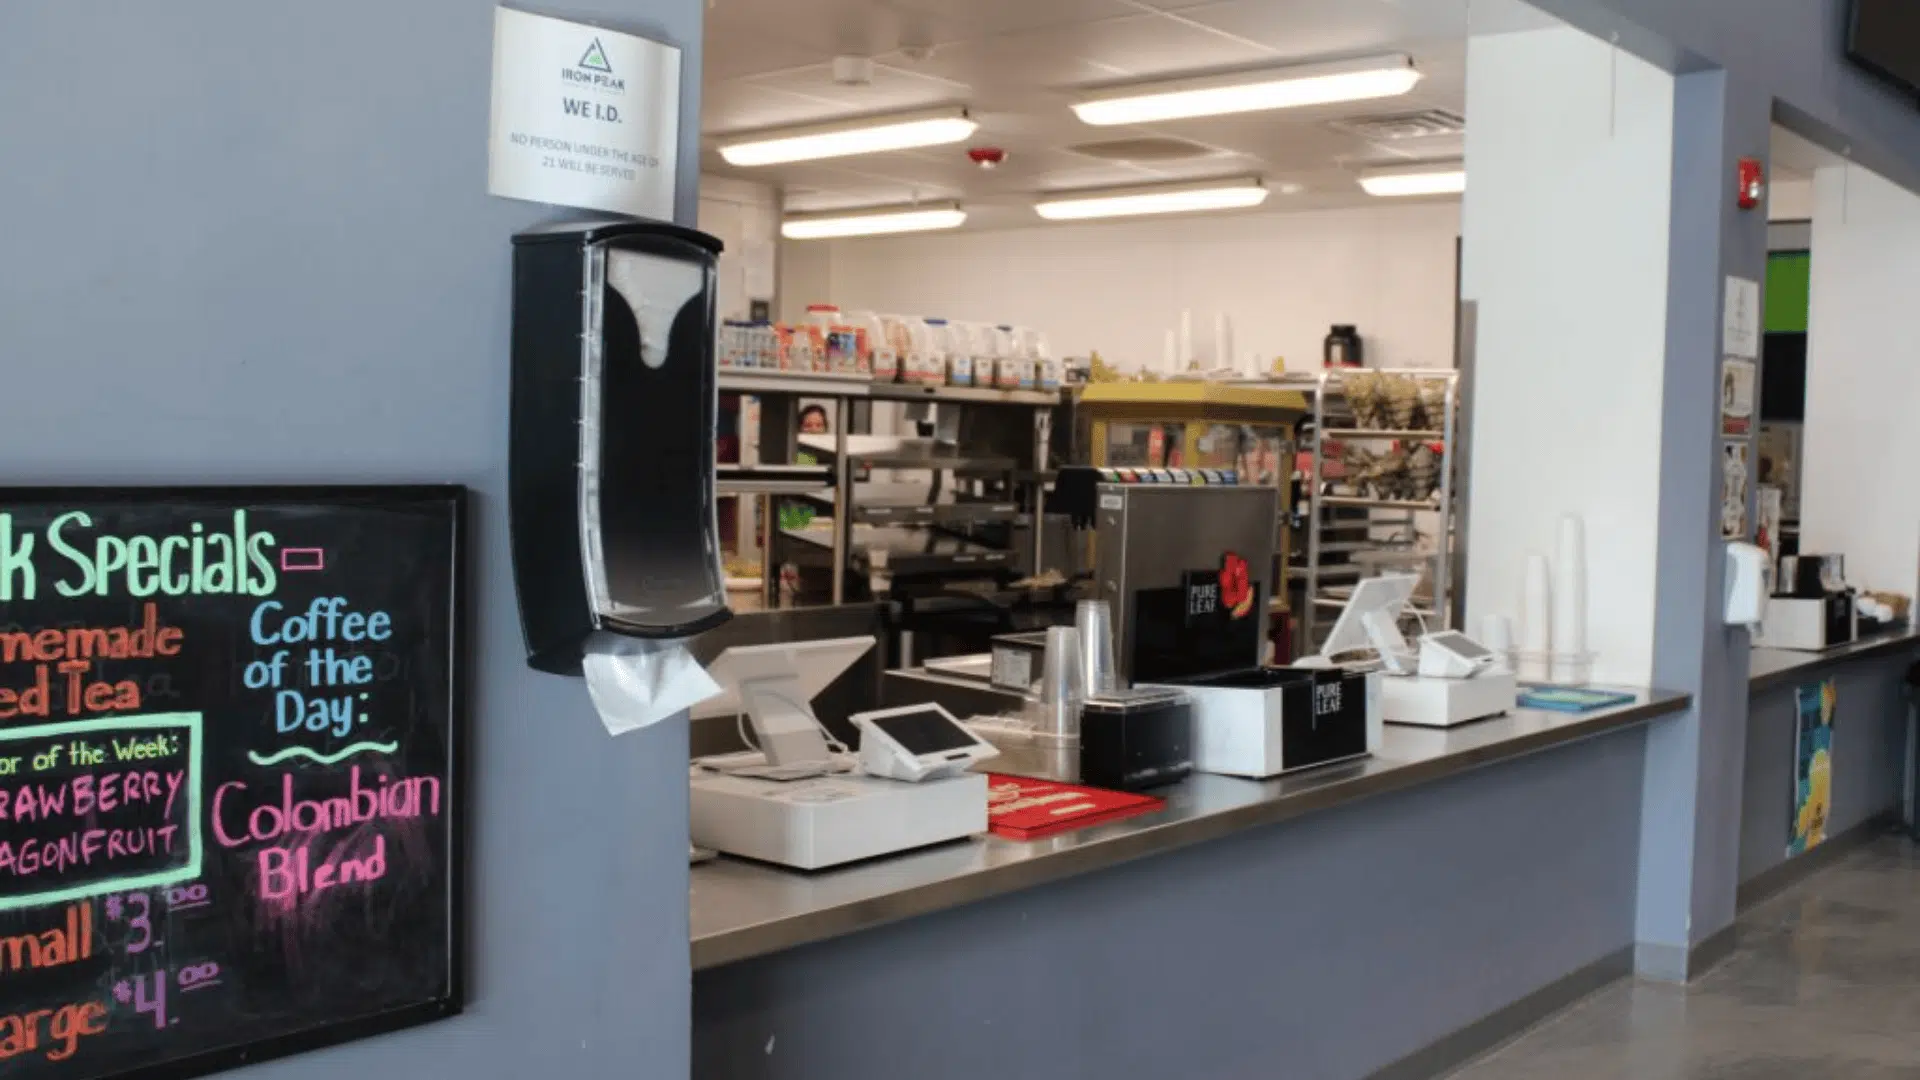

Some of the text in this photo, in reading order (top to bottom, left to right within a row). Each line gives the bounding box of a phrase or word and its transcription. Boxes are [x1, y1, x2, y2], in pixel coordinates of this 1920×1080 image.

[562, 68, 592, 83] IRON
[593, 75, 625, 90] PEAK
[562, 97, 623, 124] WE I.D.
[510, 132, 528, 146] NO
[530, 136, 571, 152] PERSON
[573, 142, 610, 158] UNDER
[612, 149, 629, 162] THE
[631, 153, 648, 167] AGE
[542, 156, 556, 168] 21
[558, 158, 583, 172] WILL
[585, 162, 597, 175] BE
[47, 510, 277, 597] Specials
[1190, 583, 1217, 599] PURE
[1190, 600, 1217, 615] LEAF
[250, 597, 392, 646] Coffee
[243, 647, 373, 689] of the
[57, 659, 141, 715] Tea
[1315, 681, 1343, 699] PURE
[275, 689, 369, 737] Day:
[1315, 698, 1343, 716] LEAF
[32, 744, 64, 771] of
[69, 740, 104, 766] the
[112, 734, 179, 760] Week:
[211, 765, 440, 848] Colombian
[258, 834, 386, 901] Blend
